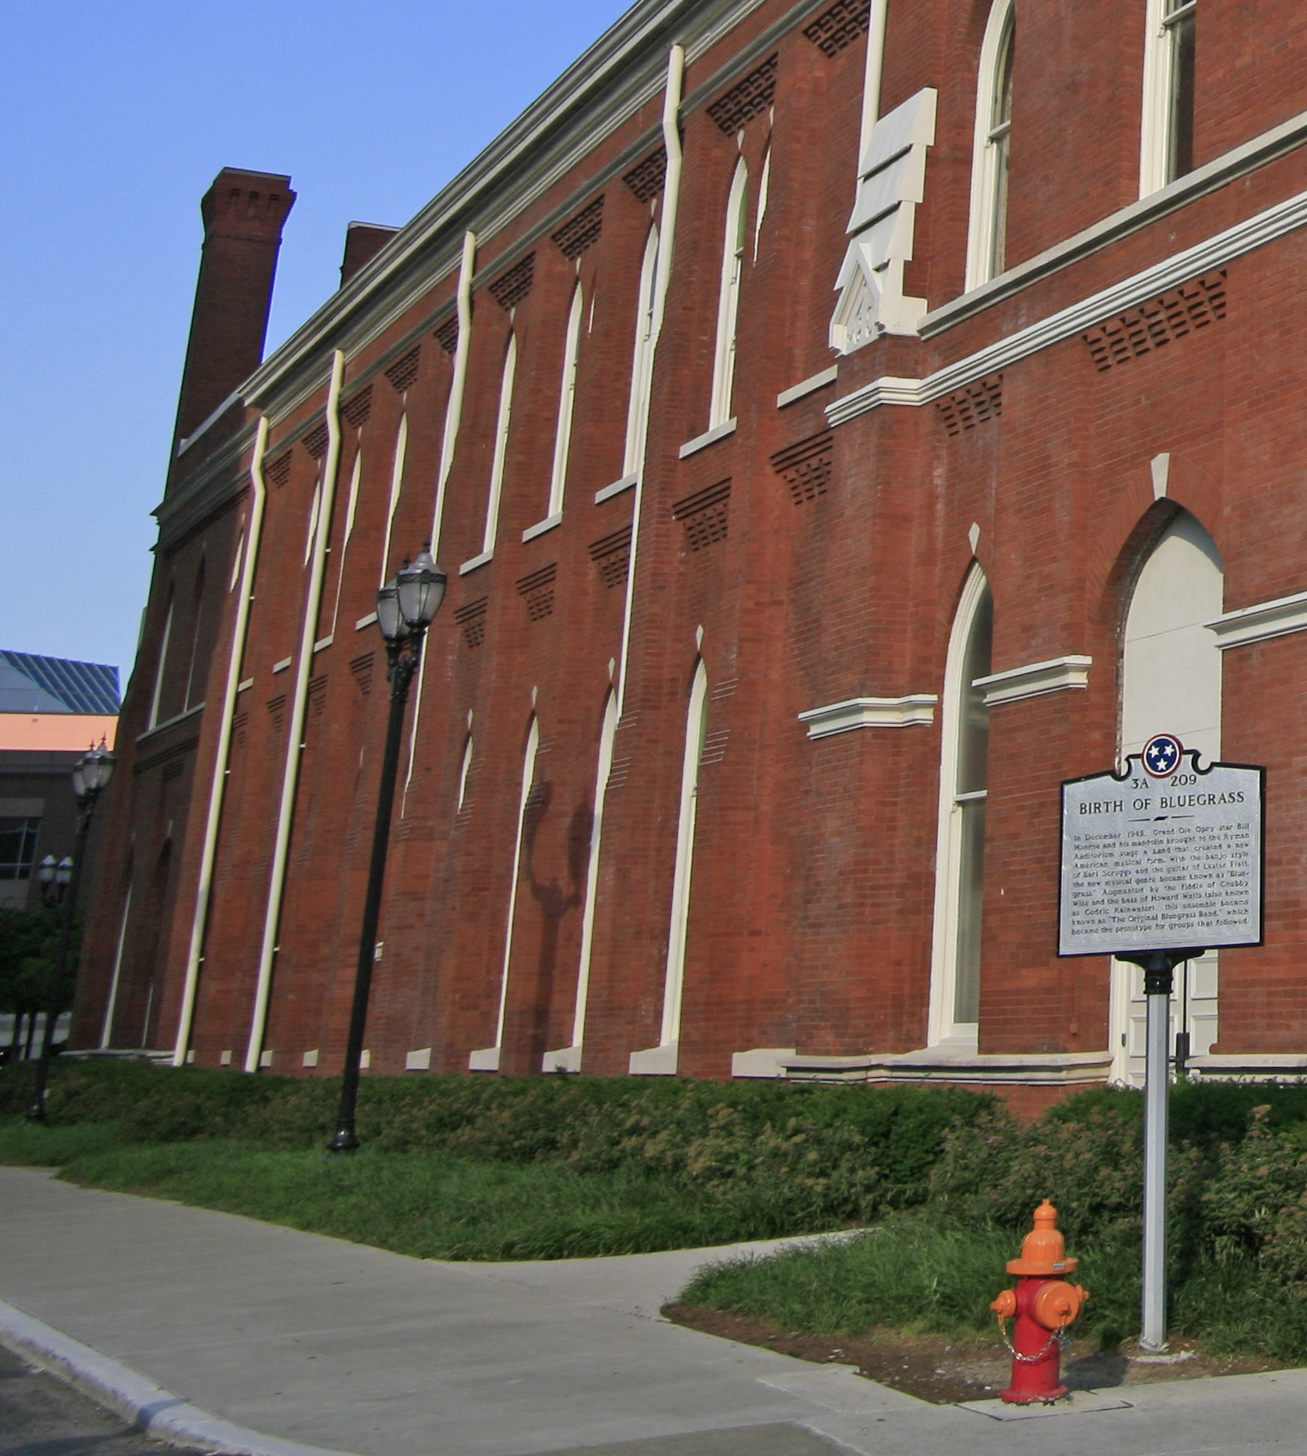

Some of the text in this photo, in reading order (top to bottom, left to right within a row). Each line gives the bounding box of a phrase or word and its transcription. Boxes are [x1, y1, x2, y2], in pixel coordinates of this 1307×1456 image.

[1131, 774, 1197, 790] 3A 209
[1079, 791, 1244, 815] BIRTH OF BLUEGRASS
